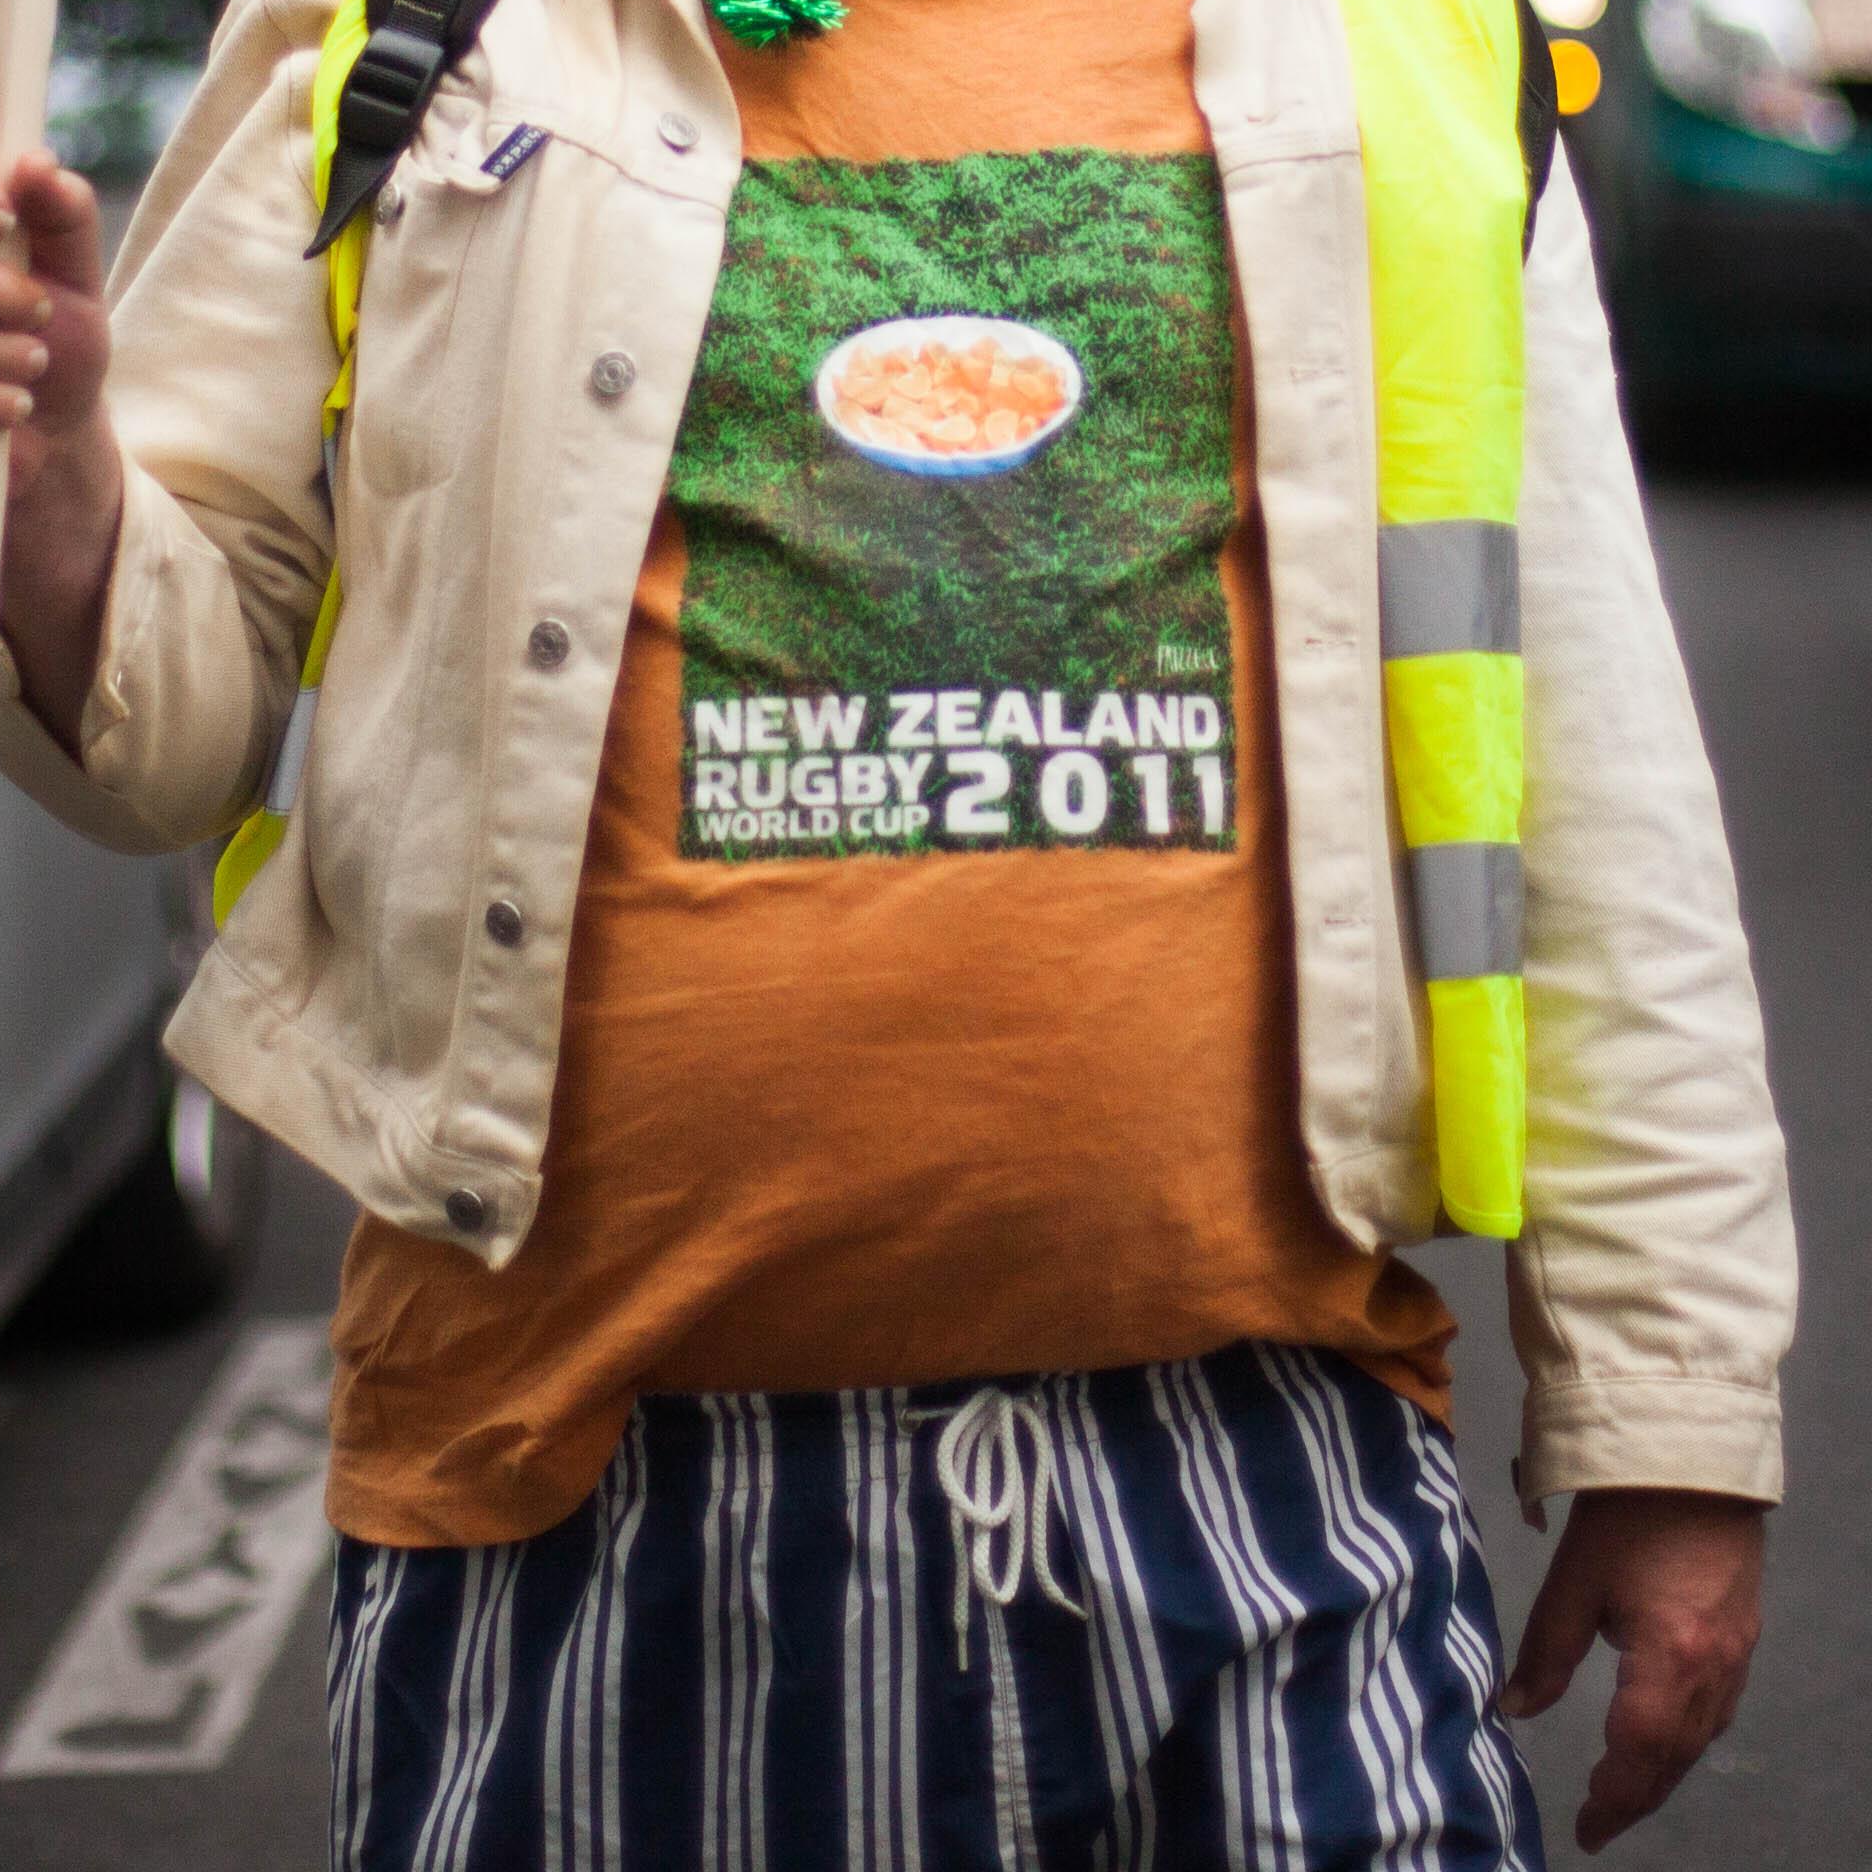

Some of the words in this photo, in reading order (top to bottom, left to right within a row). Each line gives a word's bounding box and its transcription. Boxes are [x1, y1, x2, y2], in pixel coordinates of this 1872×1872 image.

[693, 695, 867, 755] NEW
[888, 688, 1223, 749] ZEALAND
[695, 753, 933, 810] RUGBY
[945, 749, 1225, 836] 2011
[696, 806, 839, 842] WORLD
[850, 804, 930, 838] CUP
